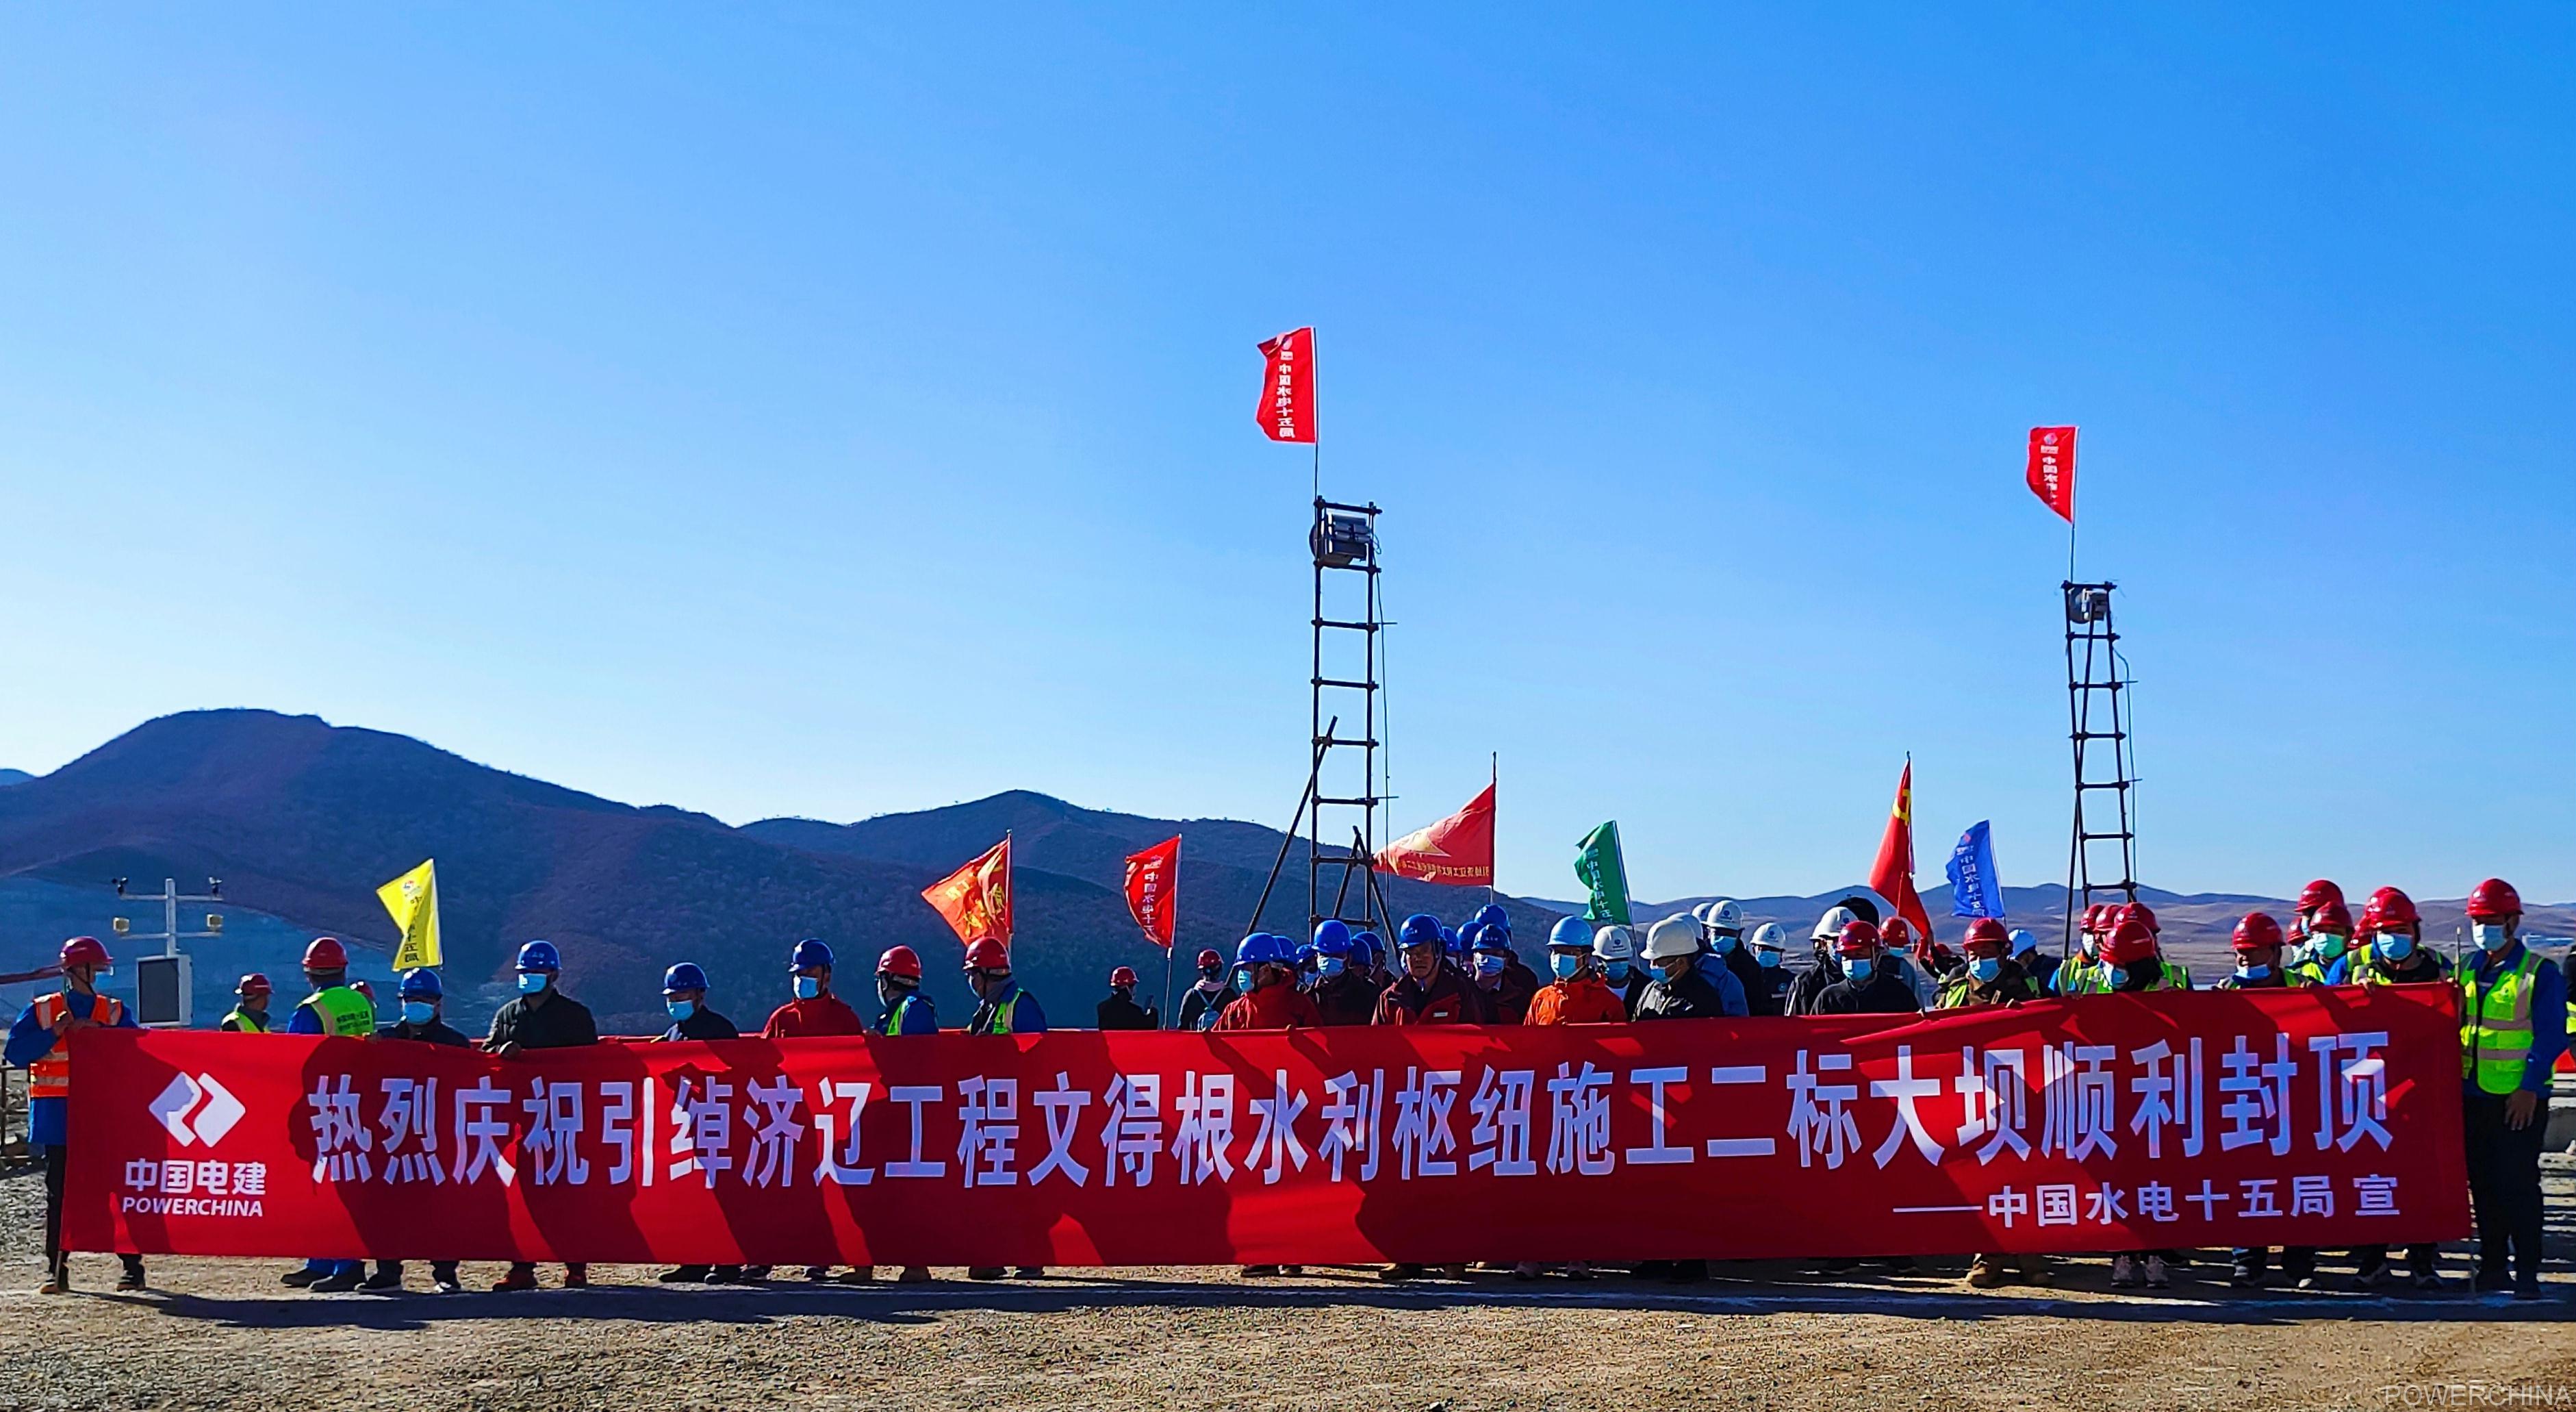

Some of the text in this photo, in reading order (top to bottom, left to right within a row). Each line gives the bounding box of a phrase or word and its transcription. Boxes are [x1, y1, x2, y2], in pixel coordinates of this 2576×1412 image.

[307, 1031, 2394, 1189] 热烈庆祝引绰济辽工程文得根水利枢纽施工二标大坝顺利封顶
[125, 1158, 266, 1196] 中国电建
[123, 1197, 263, 1217] POWERCHINA
